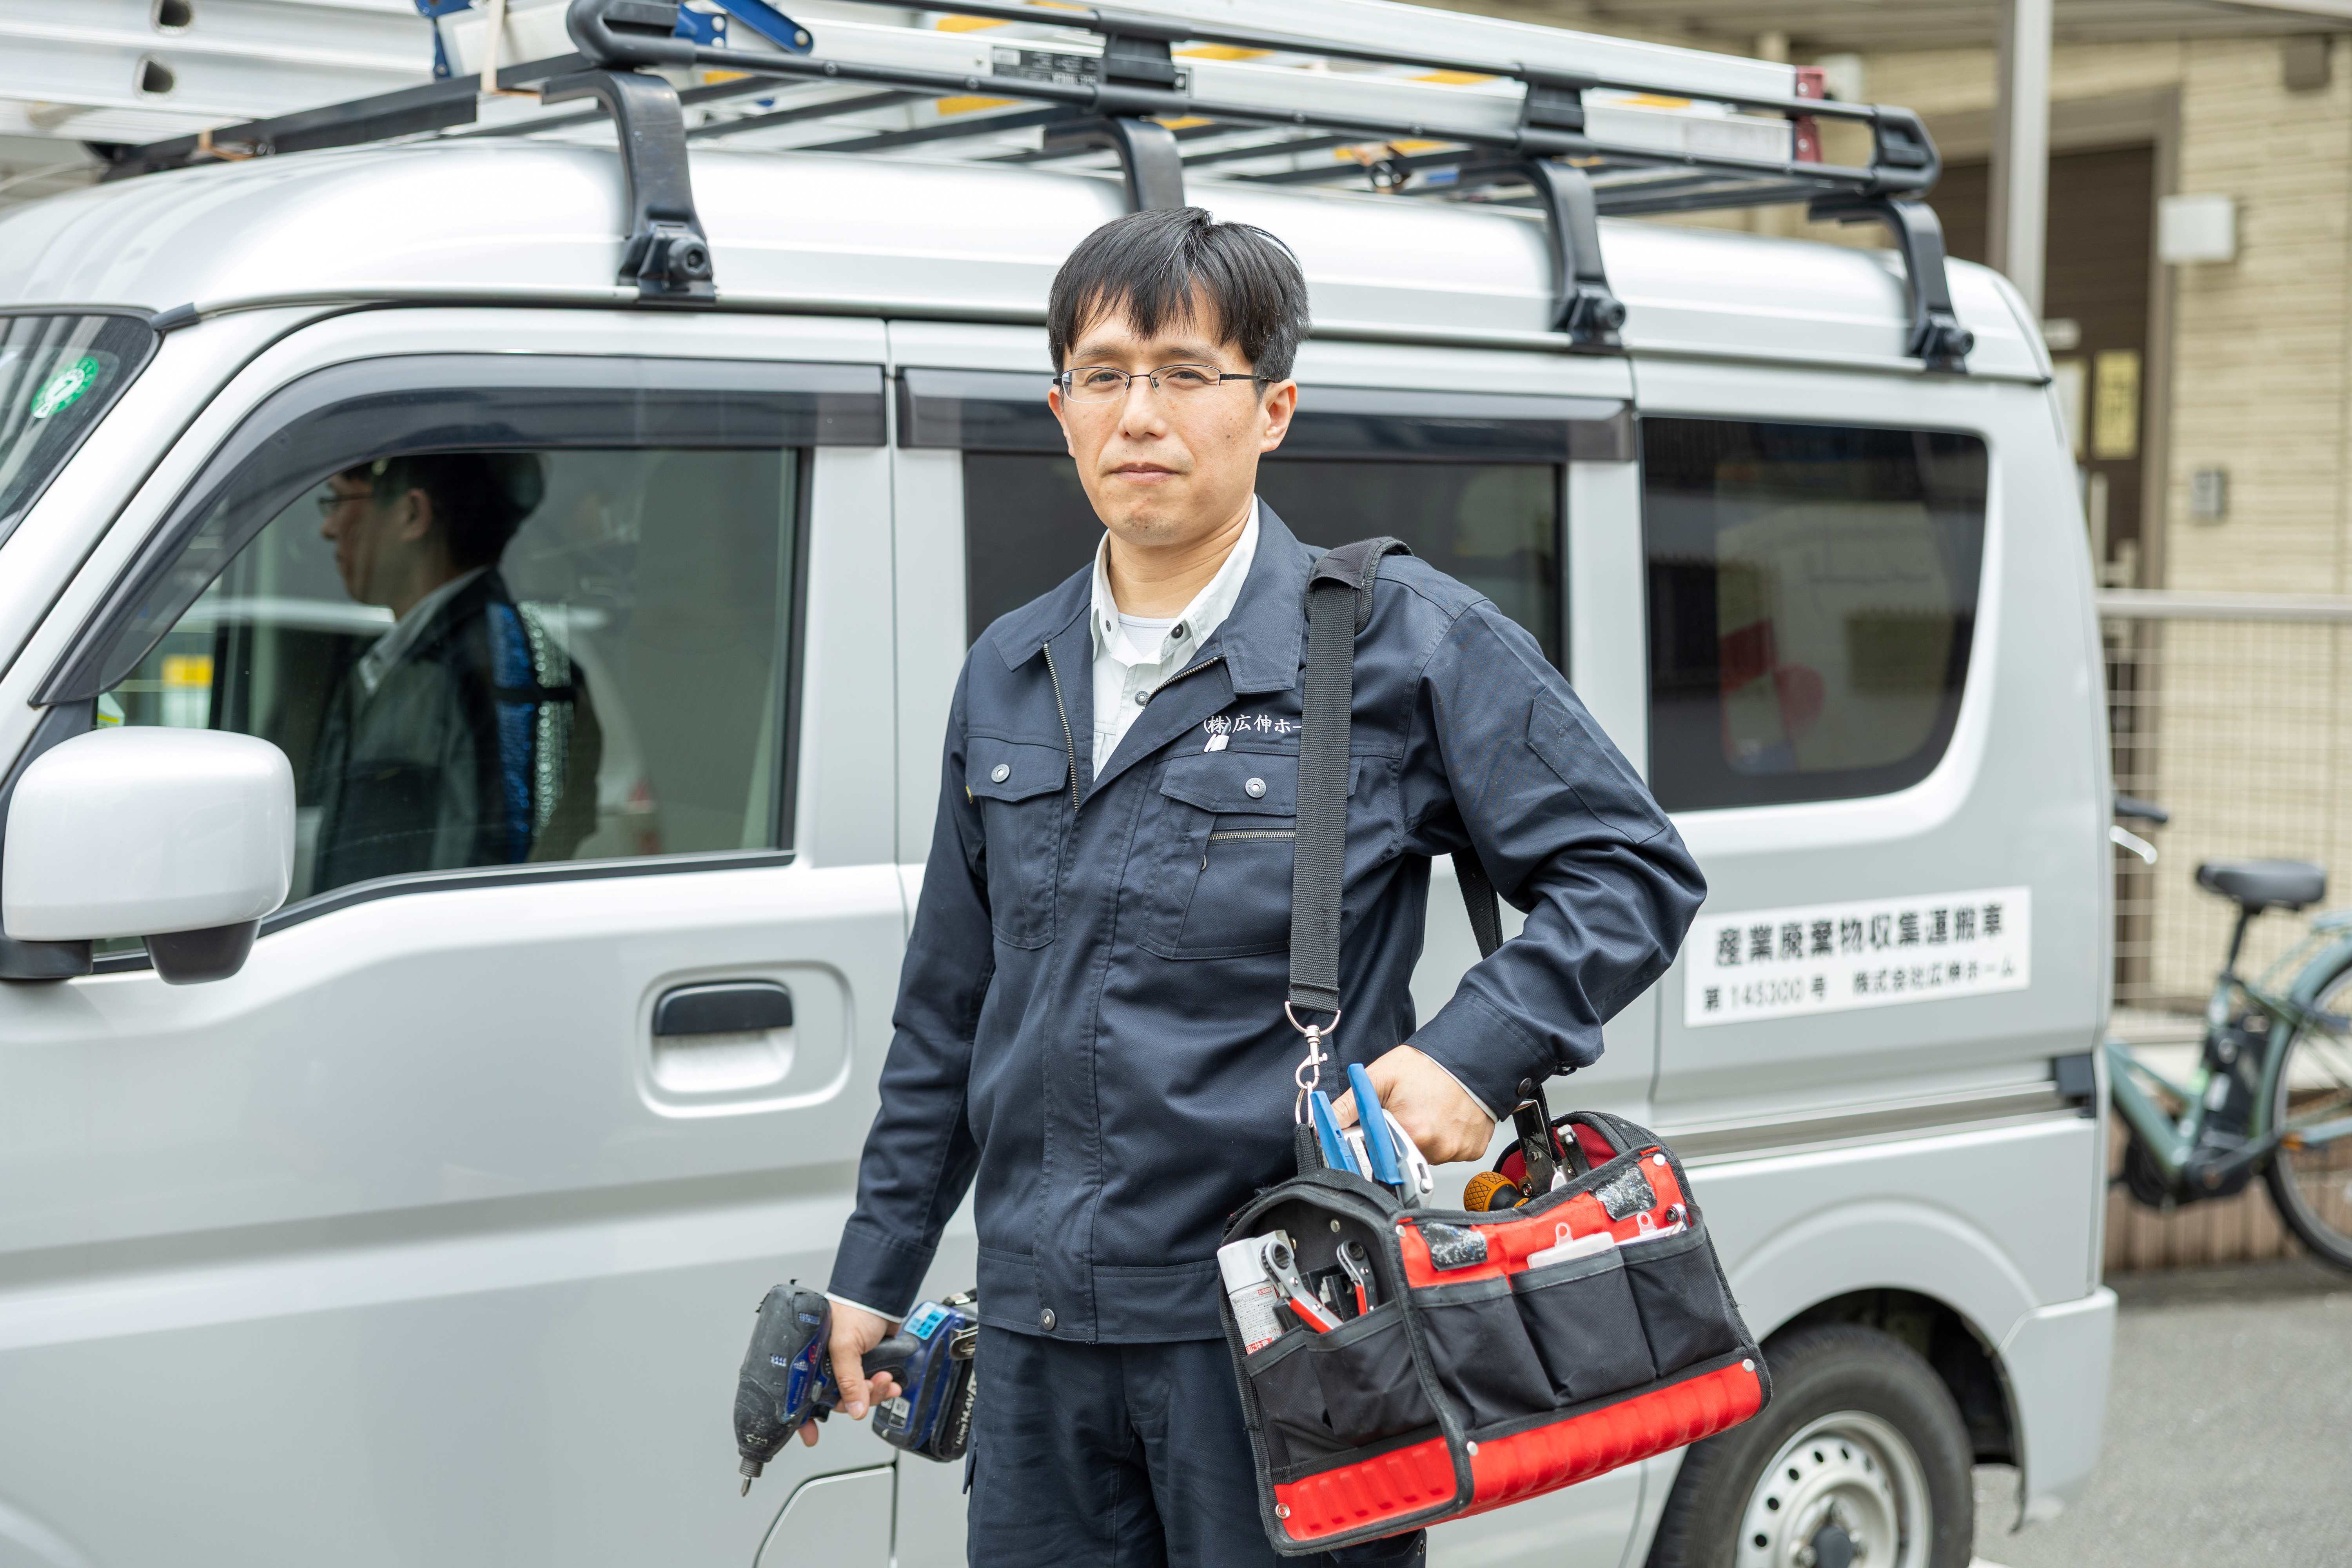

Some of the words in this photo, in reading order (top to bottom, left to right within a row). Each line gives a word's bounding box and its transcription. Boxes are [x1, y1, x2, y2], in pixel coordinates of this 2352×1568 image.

[1716, 902, 2002, 966] 産業廃棄物収集運搬車
